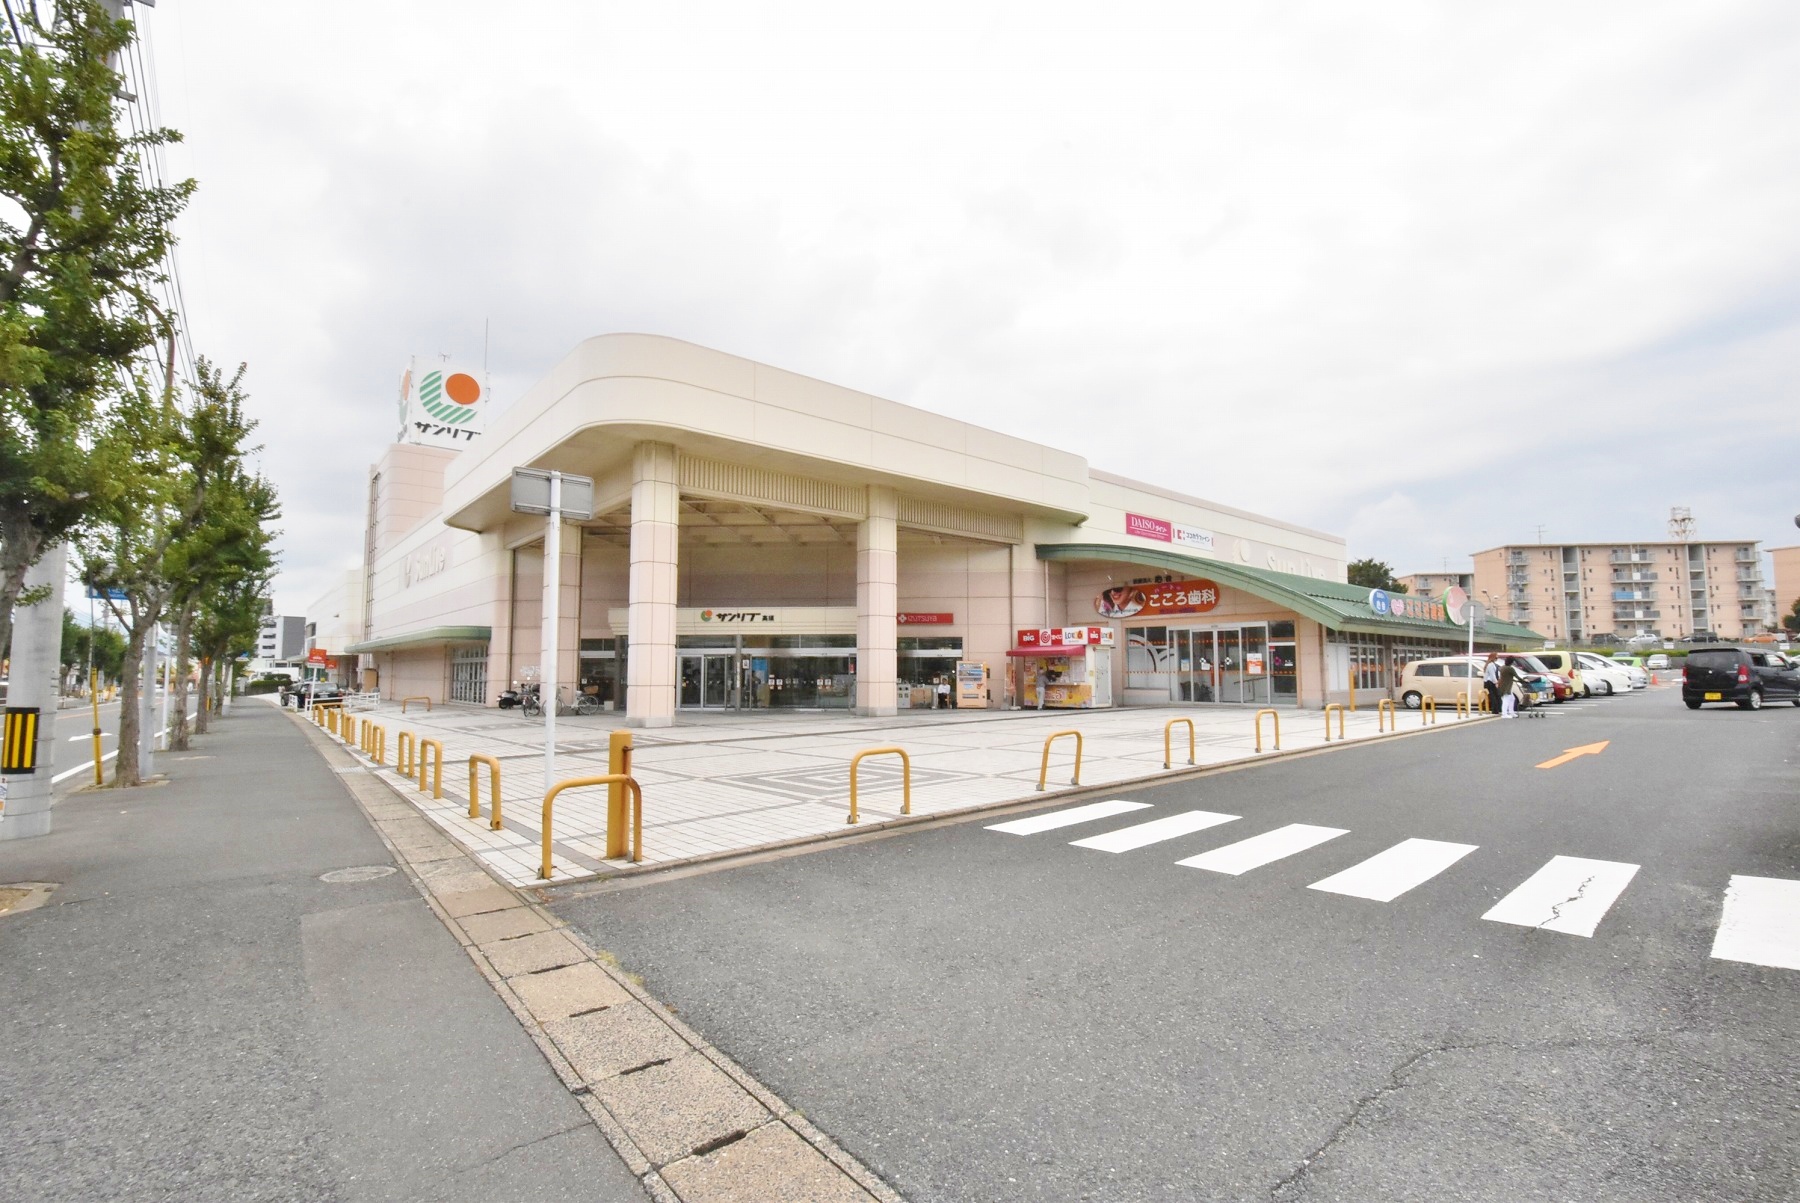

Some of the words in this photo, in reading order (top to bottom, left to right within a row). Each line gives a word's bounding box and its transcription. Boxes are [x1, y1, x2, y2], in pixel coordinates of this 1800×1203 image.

[414, 421, 482, 441] サンリブ
[1131, 516, 1155, 531] DAISO
[1149, 588, 1217, 607] こころ歯科
[716, 612, 761, 622] サンリブ
[1022, 633, 1035, 642] BIG
